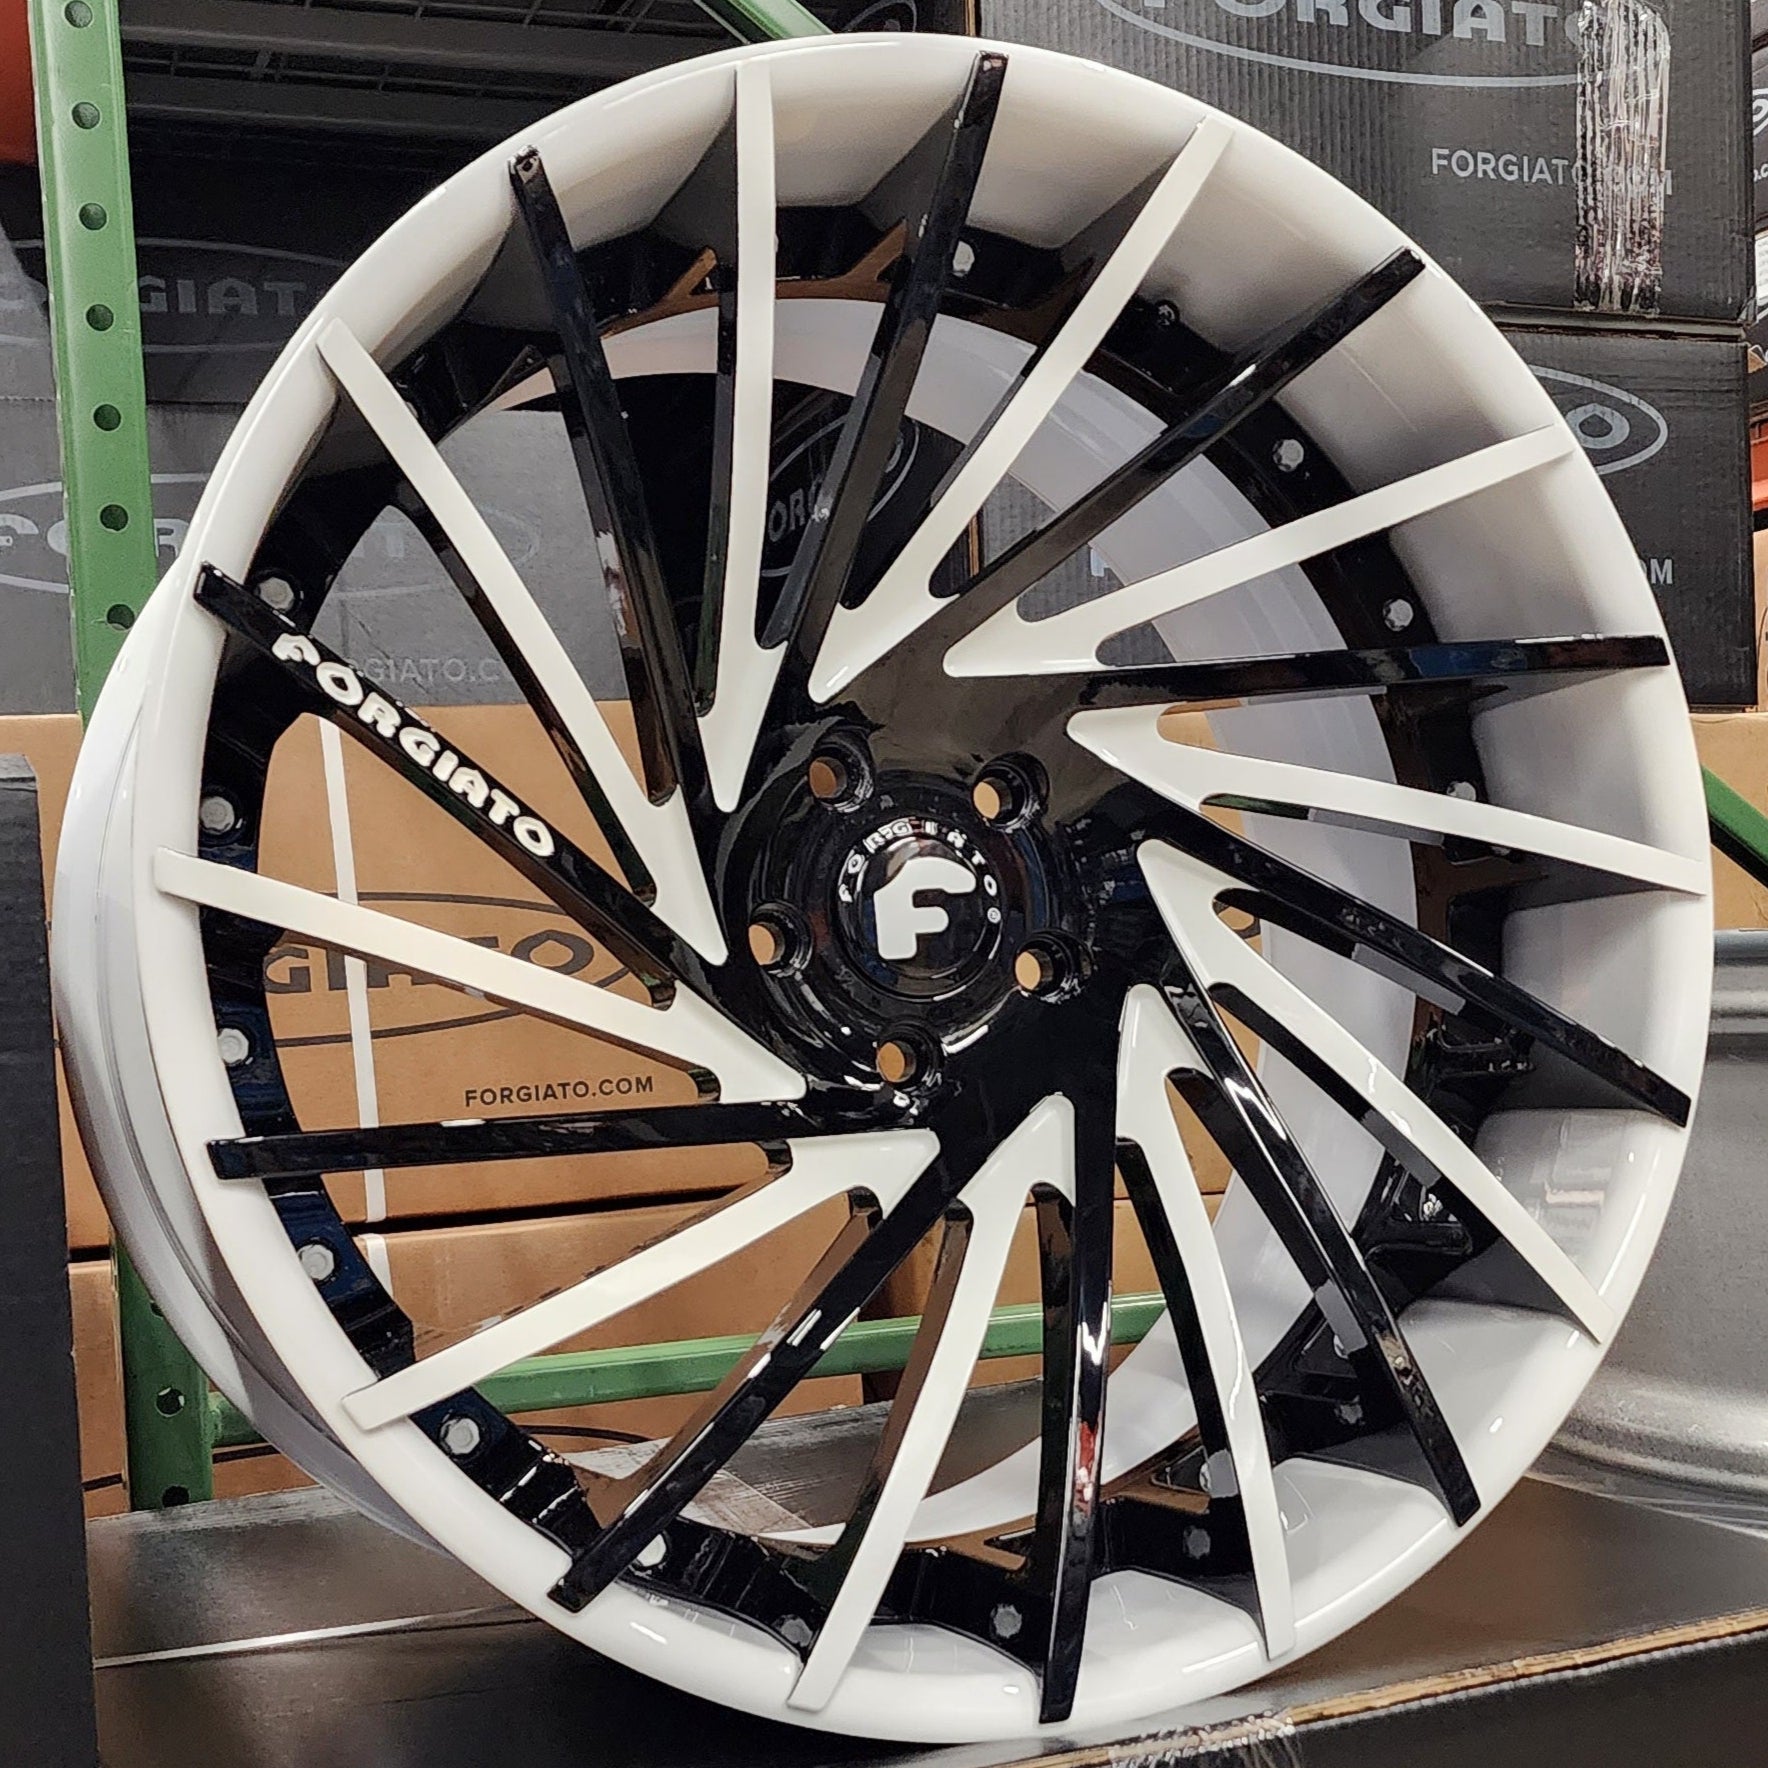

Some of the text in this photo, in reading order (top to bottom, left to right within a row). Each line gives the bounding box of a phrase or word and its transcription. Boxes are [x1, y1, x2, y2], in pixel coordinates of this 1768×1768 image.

[271, 632, 555, 857] FORGIATO
[873, 855, 977, 960] F
[464, 1075, 654, 1108] FORGIATO.COM
